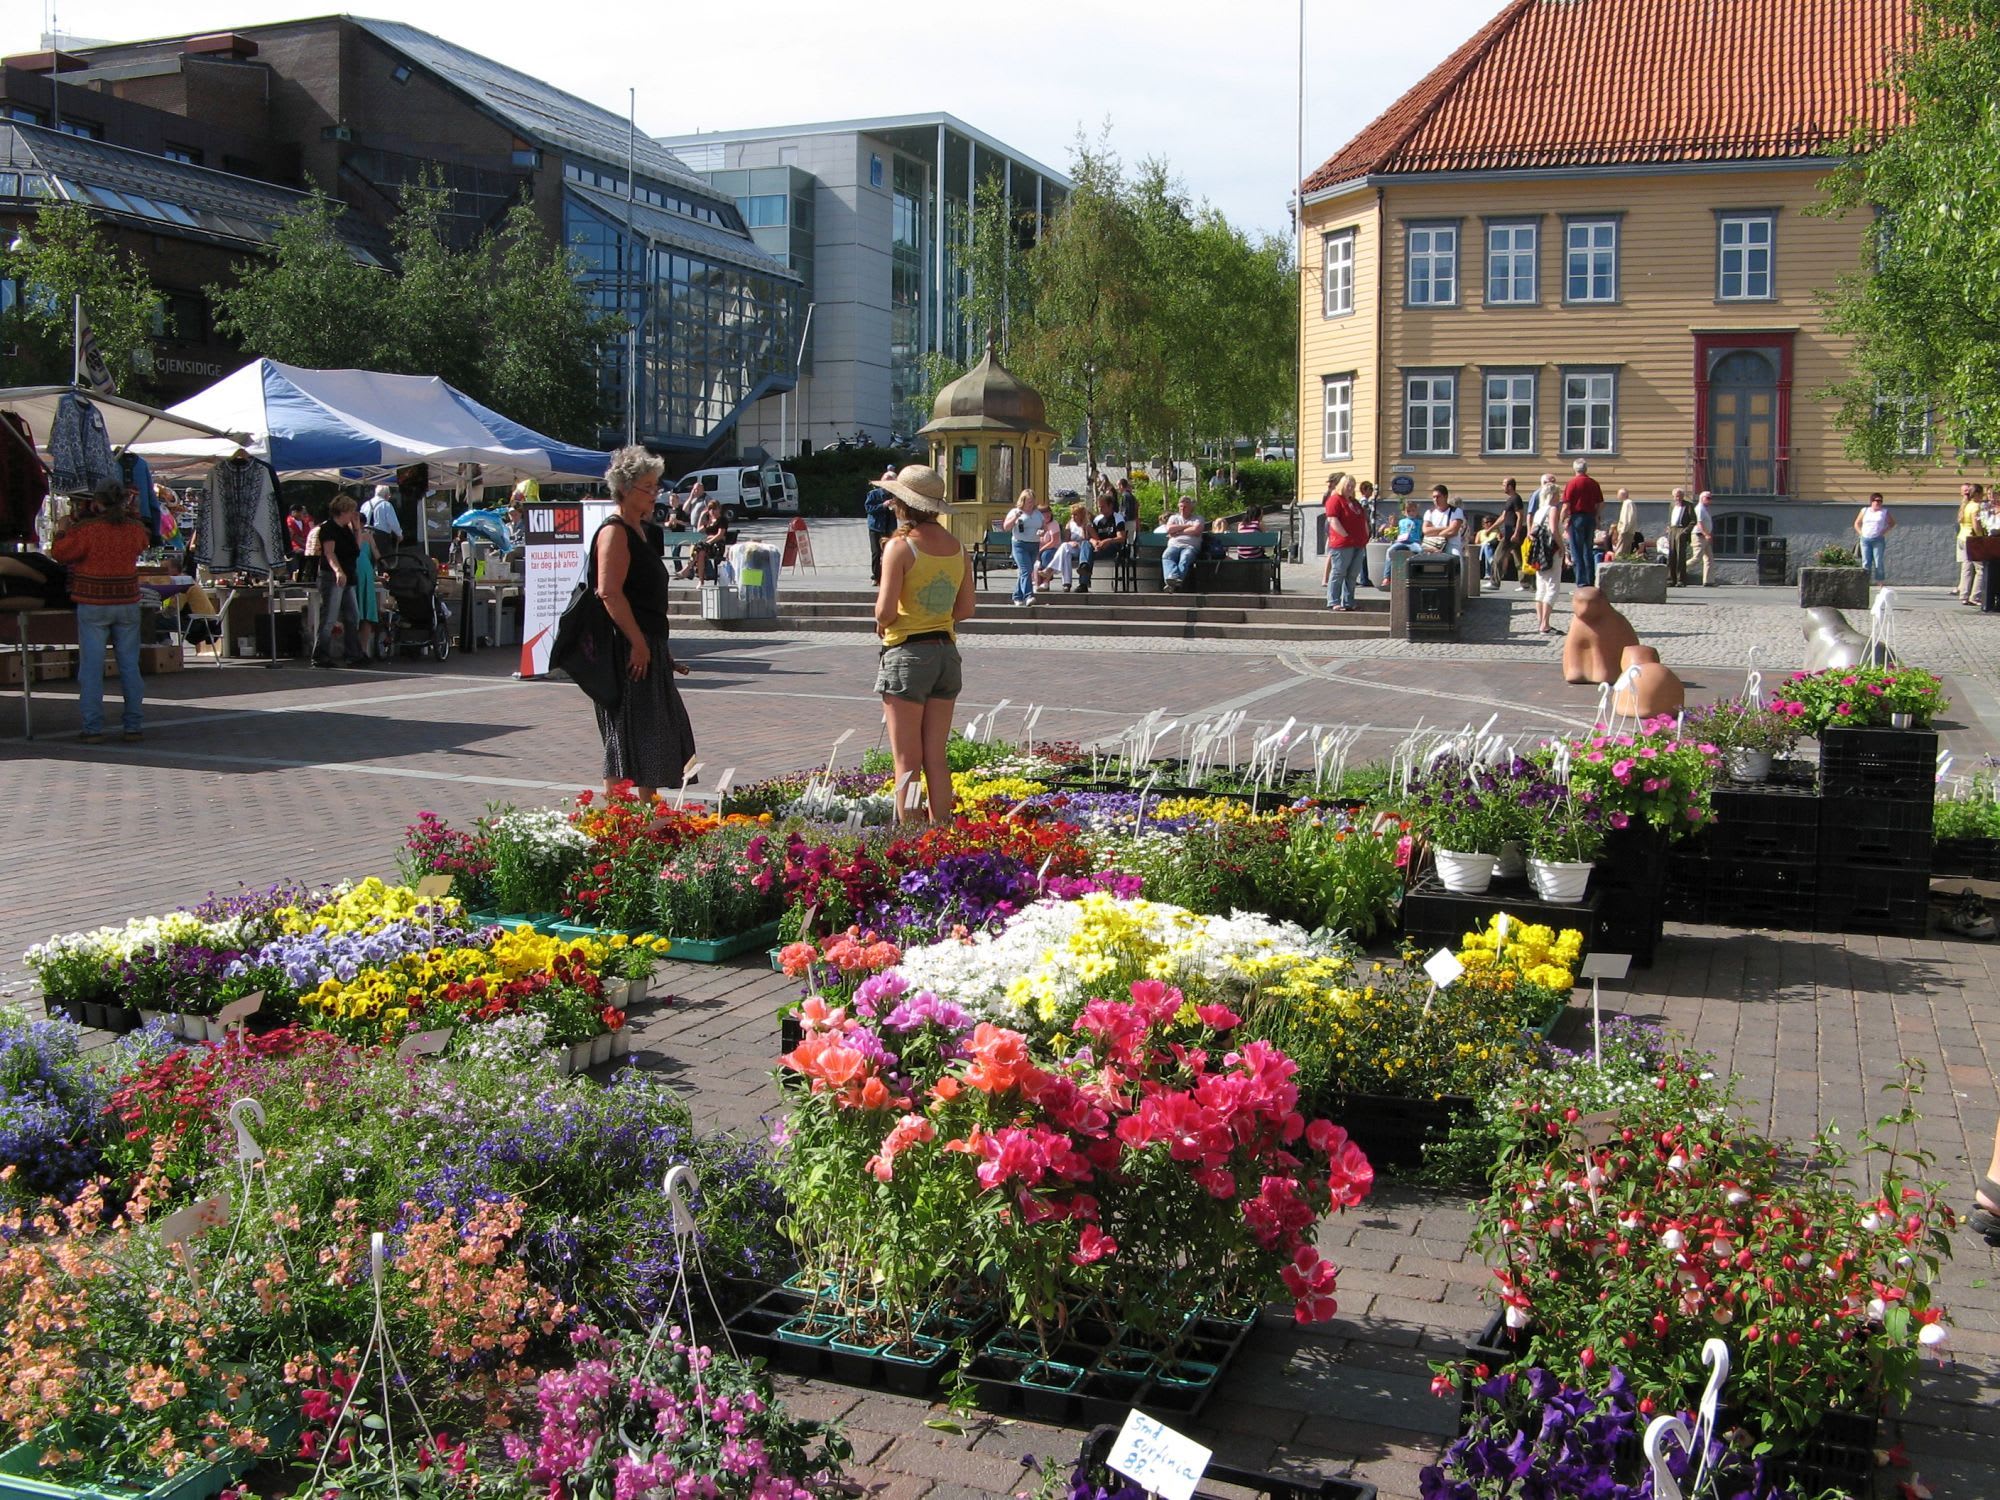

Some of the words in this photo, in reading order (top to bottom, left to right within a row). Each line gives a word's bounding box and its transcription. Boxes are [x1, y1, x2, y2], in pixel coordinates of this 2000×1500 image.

[157, 357, 222, 377] GJENSIDIGE
[531, 551, 557, 560] KILLBILL
[558, 550, 579, 559] NUTEL
[531, 561, 539, 569] tar
[541, 561, 552, 570] deg
[554, 560, 561, 569] på
[563, 560, 578, 568] alvor
